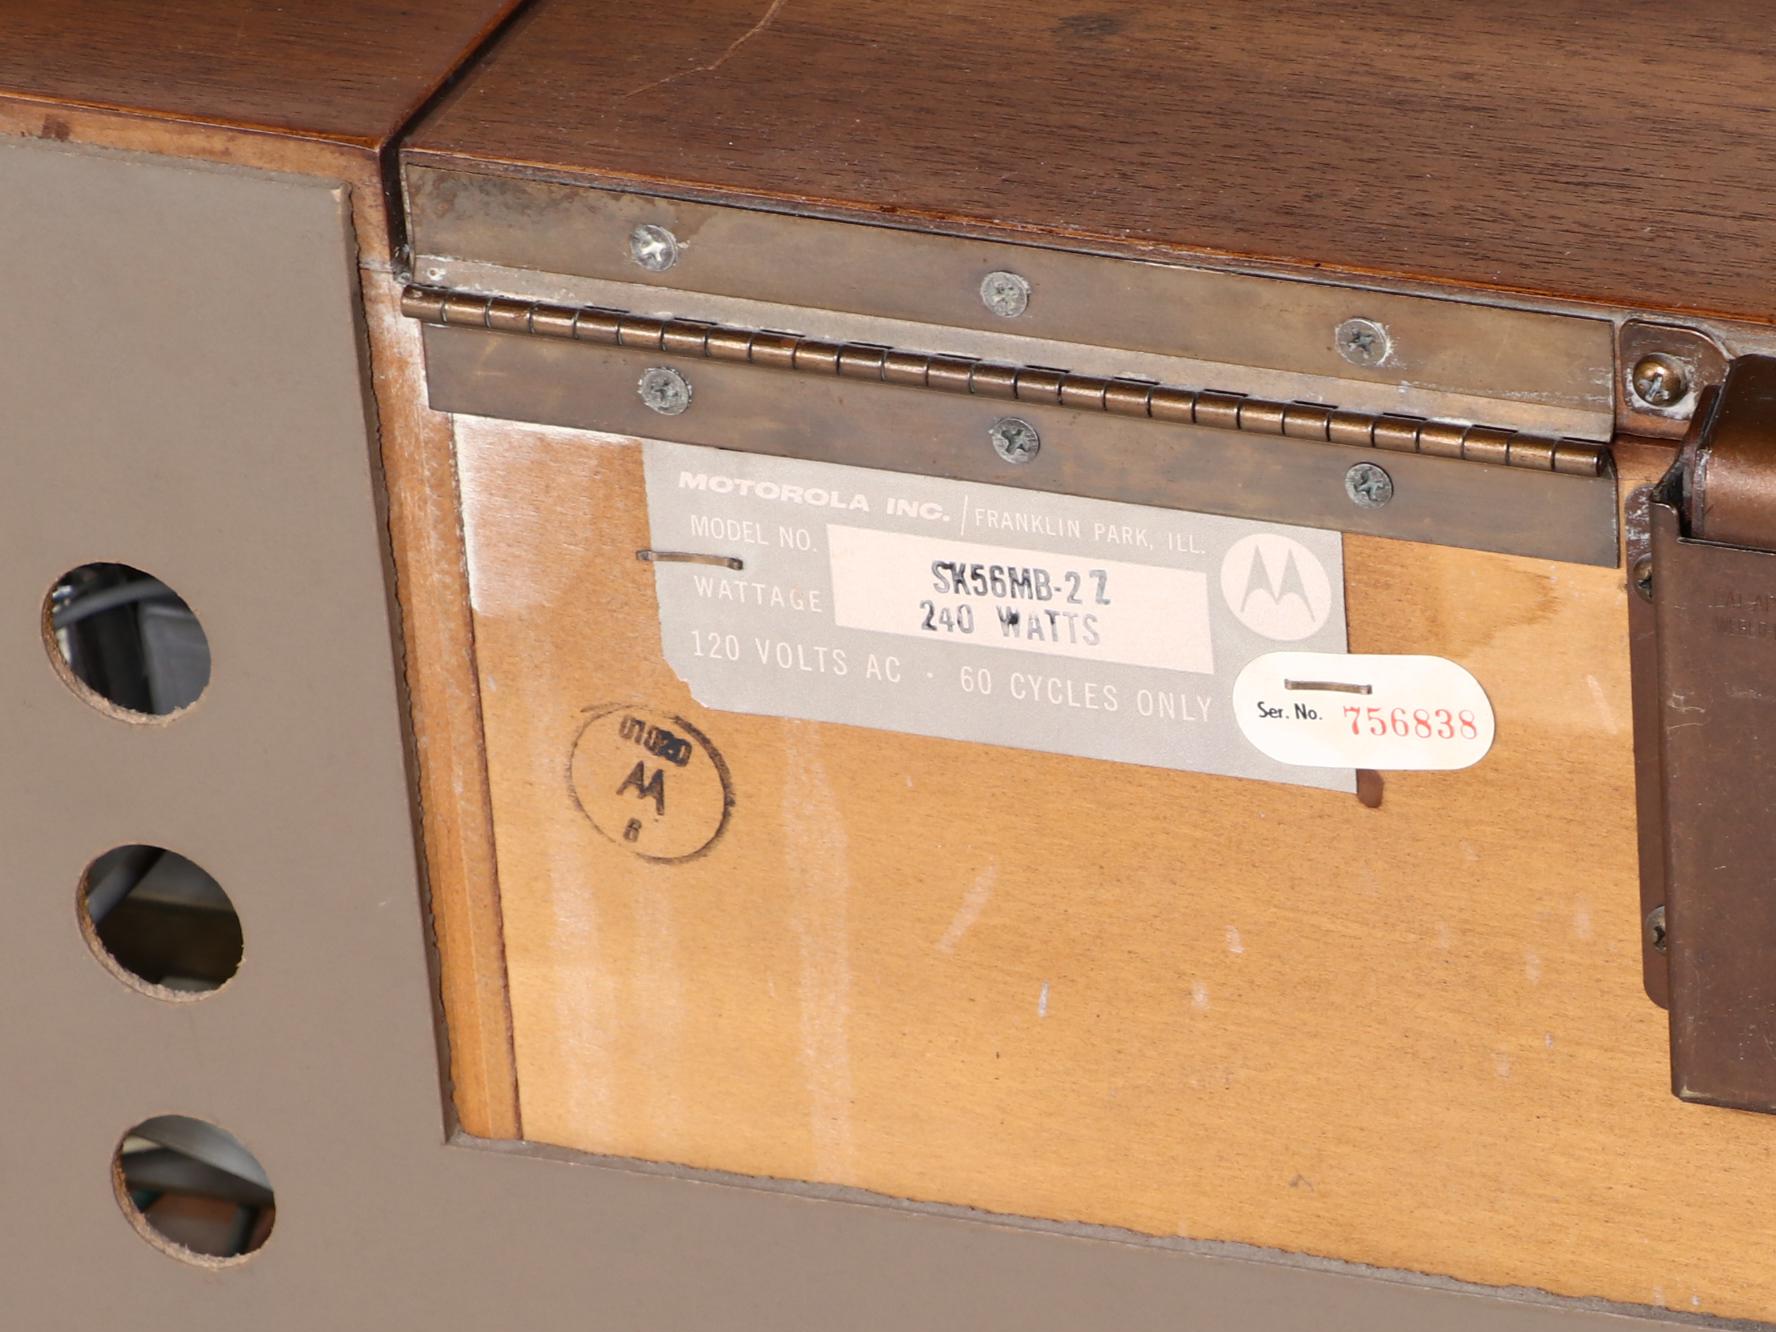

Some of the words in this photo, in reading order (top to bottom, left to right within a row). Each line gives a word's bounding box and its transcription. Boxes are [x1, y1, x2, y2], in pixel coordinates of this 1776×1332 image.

[678, 471, 869, 511] MOTOROLA
[886, 497, 950, 521] INC.
[974, 508, 1079, 537] FRANKLIN
[1094, 522, 1153, 550] PARK,
[1168, 532, 1205, 554] ILL.
[690, 514, 768, 544] MODEL
[779, 525, 816, 551] NO.
[693, 575, 822, 612] WATTAGE
[920, 601, 974, 633] 240
[996, 605, 1100, 646] WATTS
[691, 629, 739, 660] 120
[754, 637, 847, 675] VOLTS
[866, 653, 900, 682] AC
[960, 665, 991, 694] 60
[1010, 672, 1117, 711] CYCLES
[1136, 689, 1211, 721] ONLY
[1257, 701, 1289, 719] Ser.
[1294, 703, 1322, 720] No.
[1343, 705, 1478, 739] 756838
